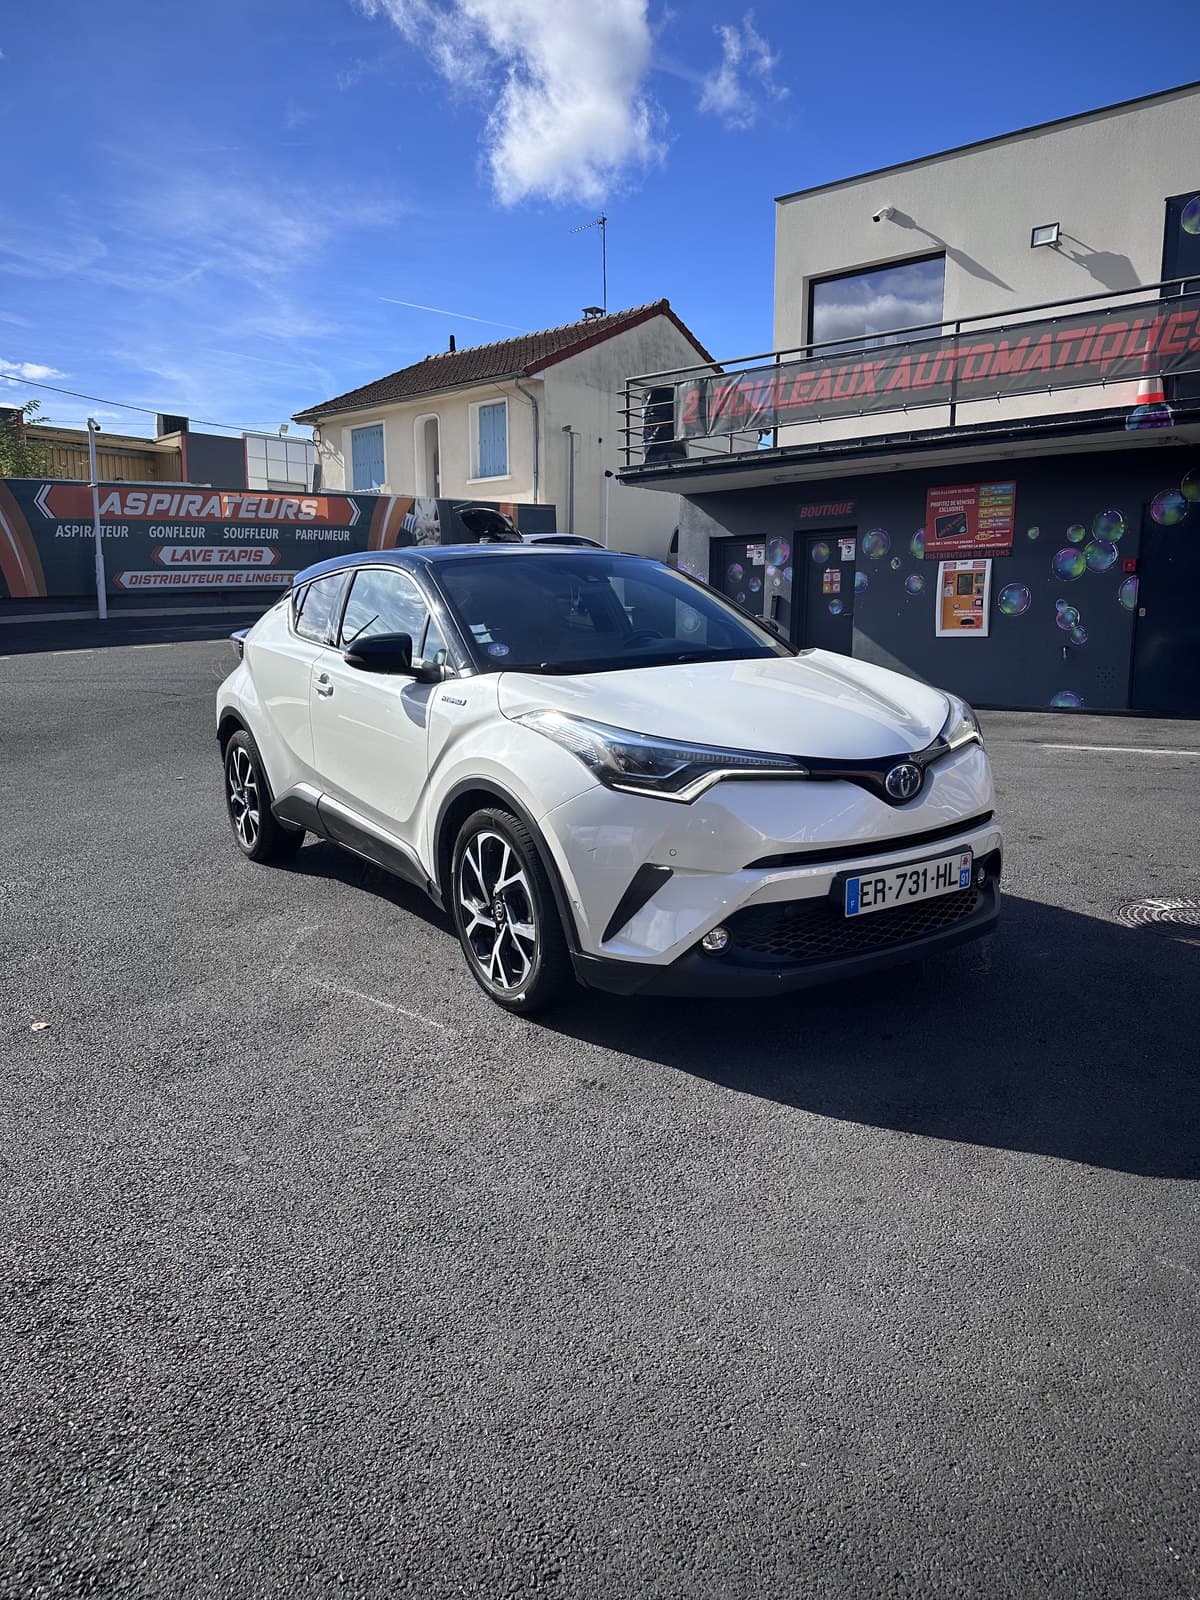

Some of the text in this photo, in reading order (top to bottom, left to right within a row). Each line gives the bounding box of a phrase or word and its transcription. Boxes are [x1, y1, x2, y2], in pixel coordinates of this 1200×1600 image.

[682, 389, 700, 425] 2
[99, 492, 318, 520] ASPIRATEURS
[800, 502, 854, 517] BOUTIQUE
[55, 524, 351, 542] ASPIRATEUR GONFLEUR SOUFFLEUR PARFUMEUR
[170, 549, 263, 563] LAVE TAPIS
[128, 573, 223, 585] DISTRIBUTEUR
[226, 573, 242, 584] DE
[860, 862, 970, 908] ER-731-HL 91
[850, 900, 856, 909] F
